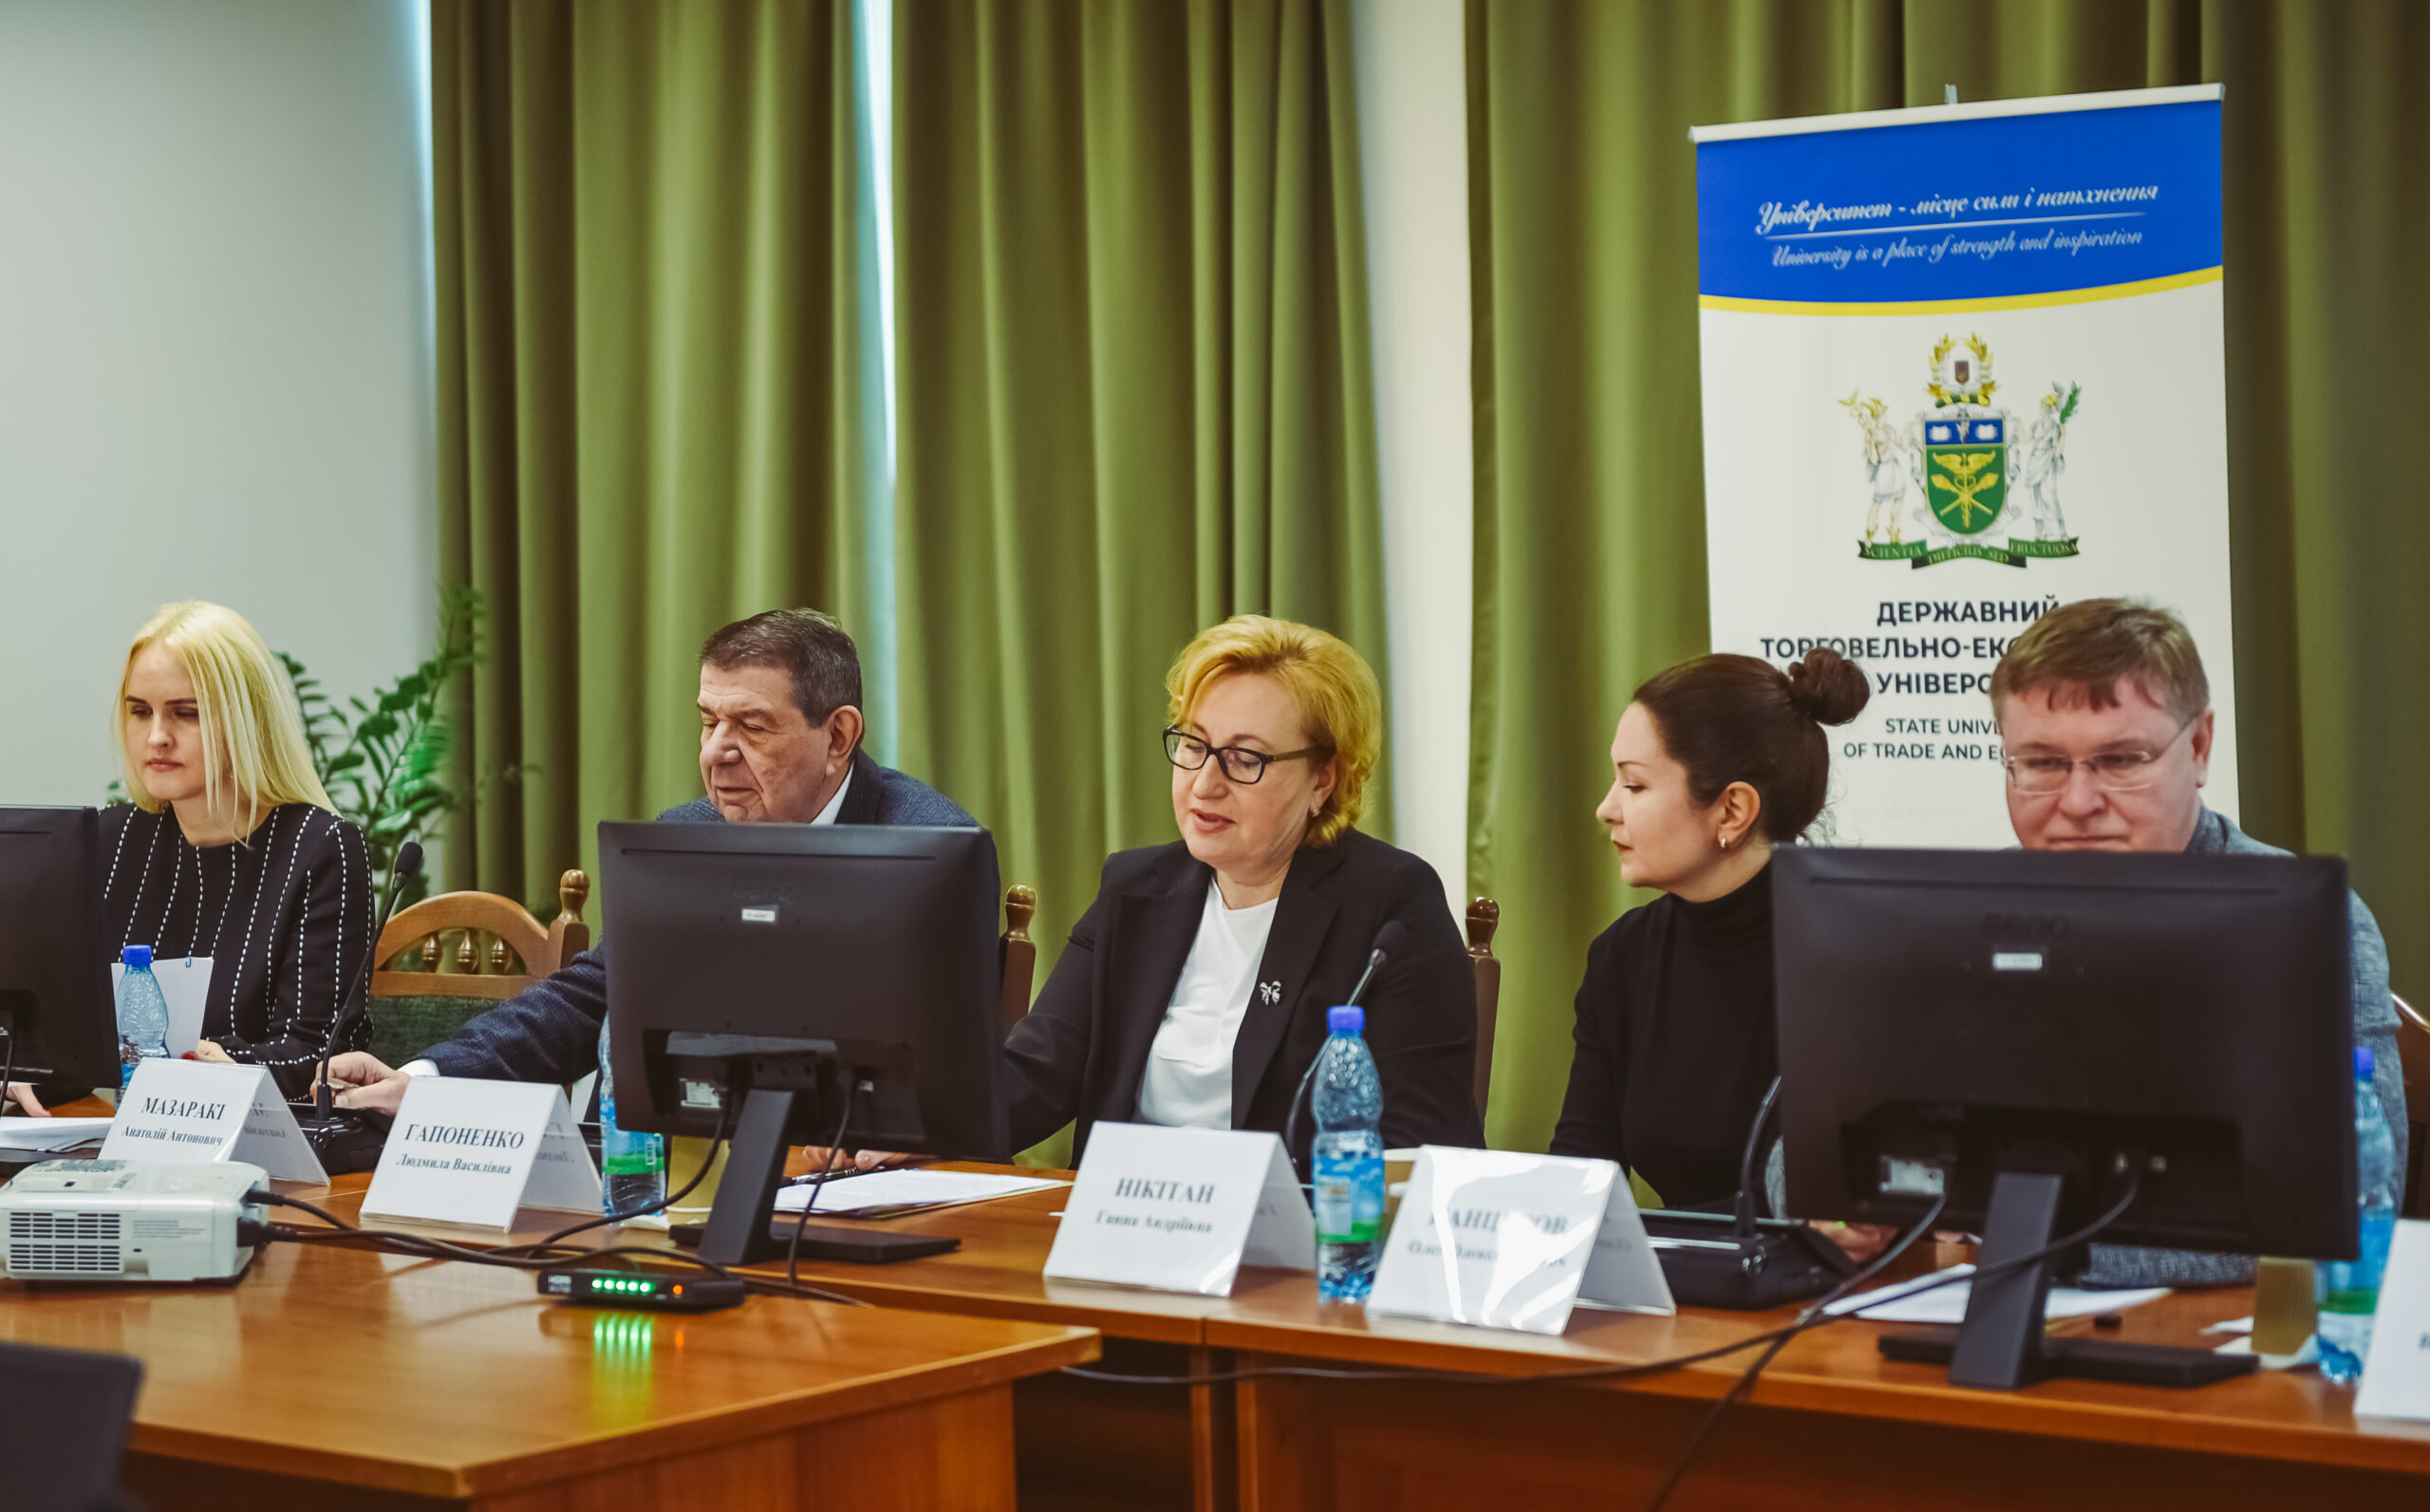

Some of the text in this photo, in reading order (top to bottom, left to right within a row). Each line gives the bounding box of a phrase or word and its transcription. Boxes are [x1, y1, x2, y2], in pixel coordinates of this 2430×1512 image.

[1755, 199, 1893, 234] Університет
[1910, 193, 1969, 219] місце
[1972, 194, 2020, 212] сили
[2024, 186, 2036, 208] і
[2036, 185, 2159, 208] натхнення
[1772, 228, 2143, 271] University is a place of strength and inspiration
[1885, 718, 1941, 735] STATE
[1843, 742, 1867, 758] OF
[1873, 743, 1935, 759] TRADE
[1942, 743, 1983, 759] AND
[140, 1097, 227, 1121] МАЗАРАКІ
[122, 1125, 224, 1147] Анатолій Антонович
[404, 1124, 525, 1150] ГАПОНЕНКО
[396, 1153, 513, 1175] Людмила Василівна
